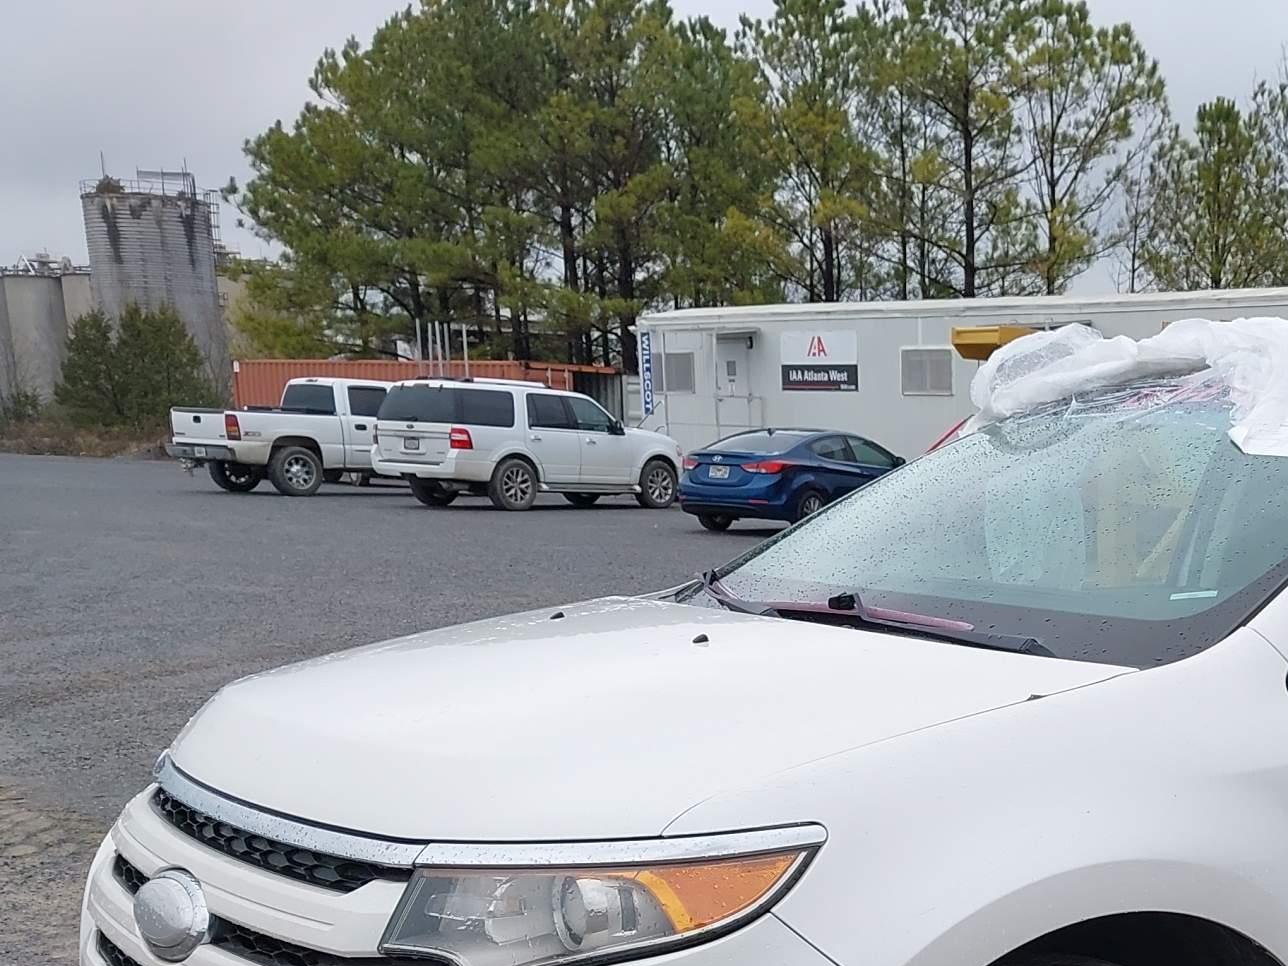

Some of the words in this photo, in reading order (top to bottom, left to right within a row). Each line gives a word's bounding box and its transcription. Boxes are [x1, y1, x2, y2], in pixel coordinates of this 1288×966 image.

[642, 334, 653, 414] WILLSCOT
[789, 370, 803, 382] IAA
[804, 370, 829, 382] Atlanta
[829, 370, 848, 382] West
